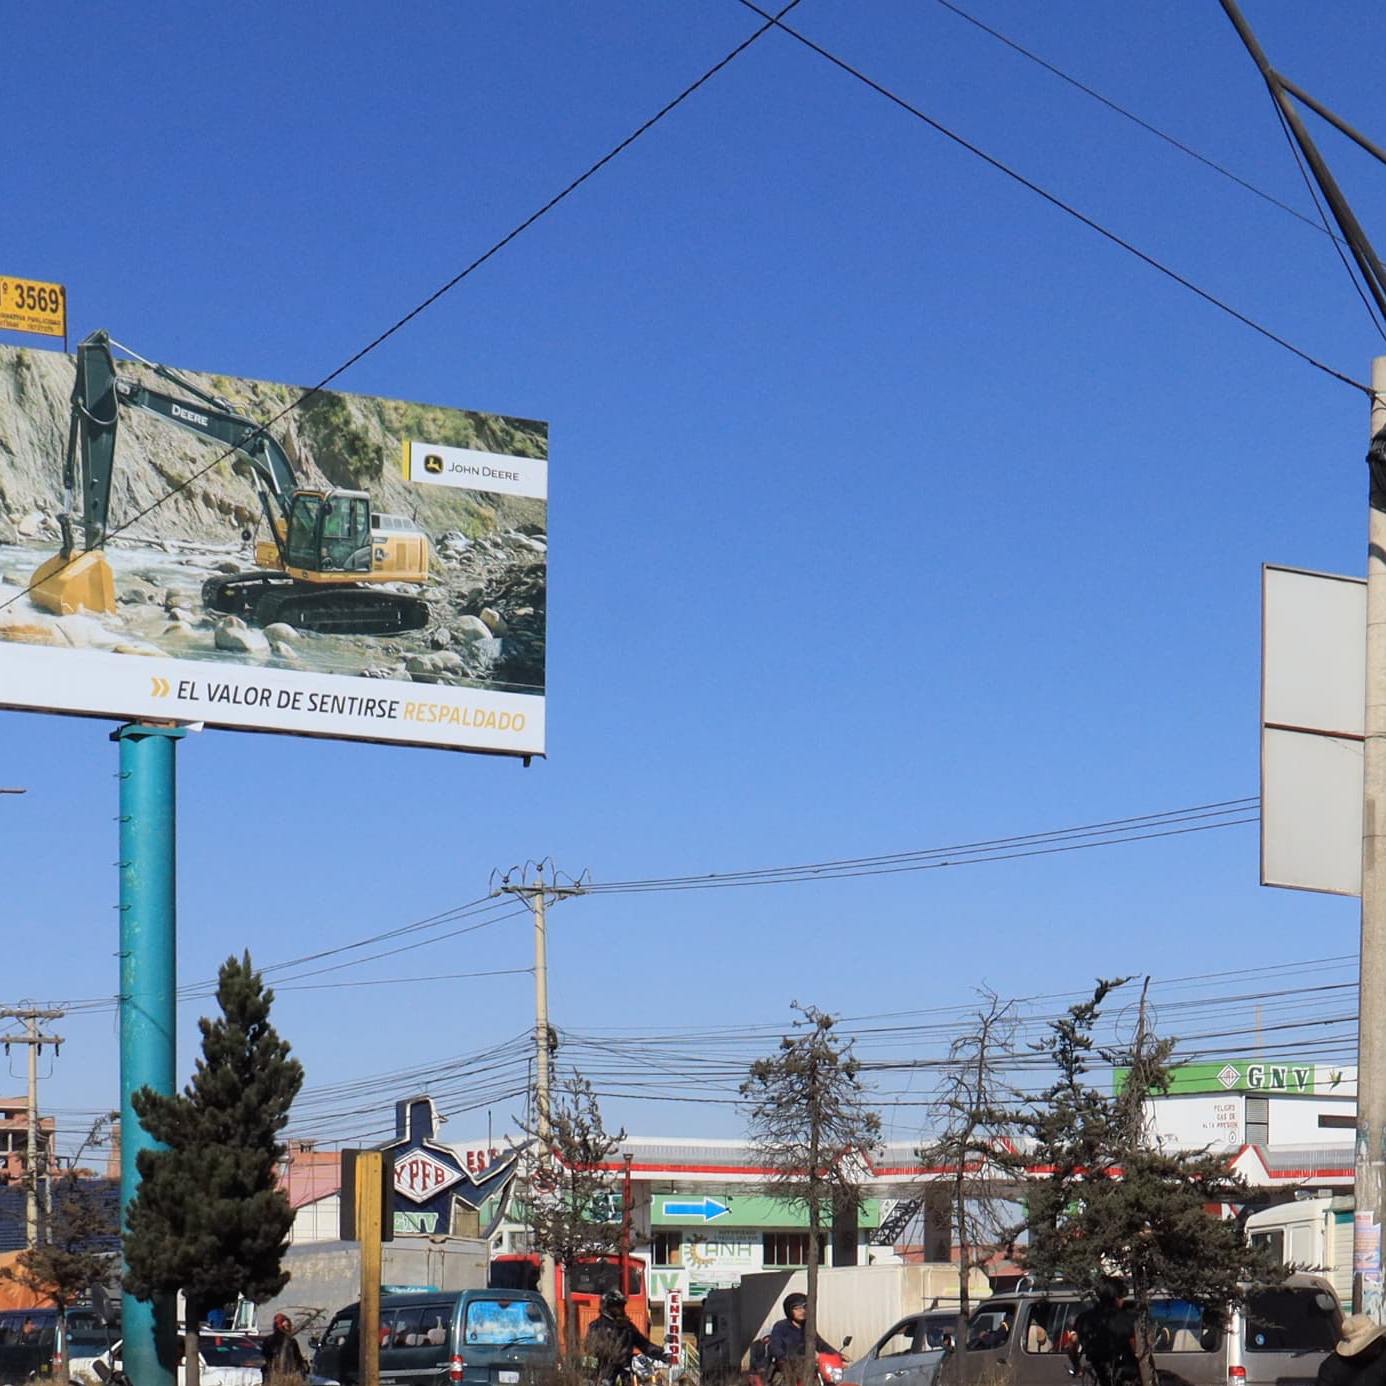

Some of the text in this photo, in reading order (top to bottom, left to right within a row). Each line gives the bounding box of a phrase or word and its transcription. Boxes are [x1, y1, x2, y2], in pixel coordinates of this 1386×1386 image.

[15, 283, 59, 313] 3569
[172, 403, 209, 427] DEERE
[177, 681, 526, 732] EL VALOR DE SENTIRSE RESPALDADO
[1247, 1064, 1310, 1092] GNV
[393, 1159, 445, 1192] YPFB
[669, 1294, 680, 1365] ENTRADA
